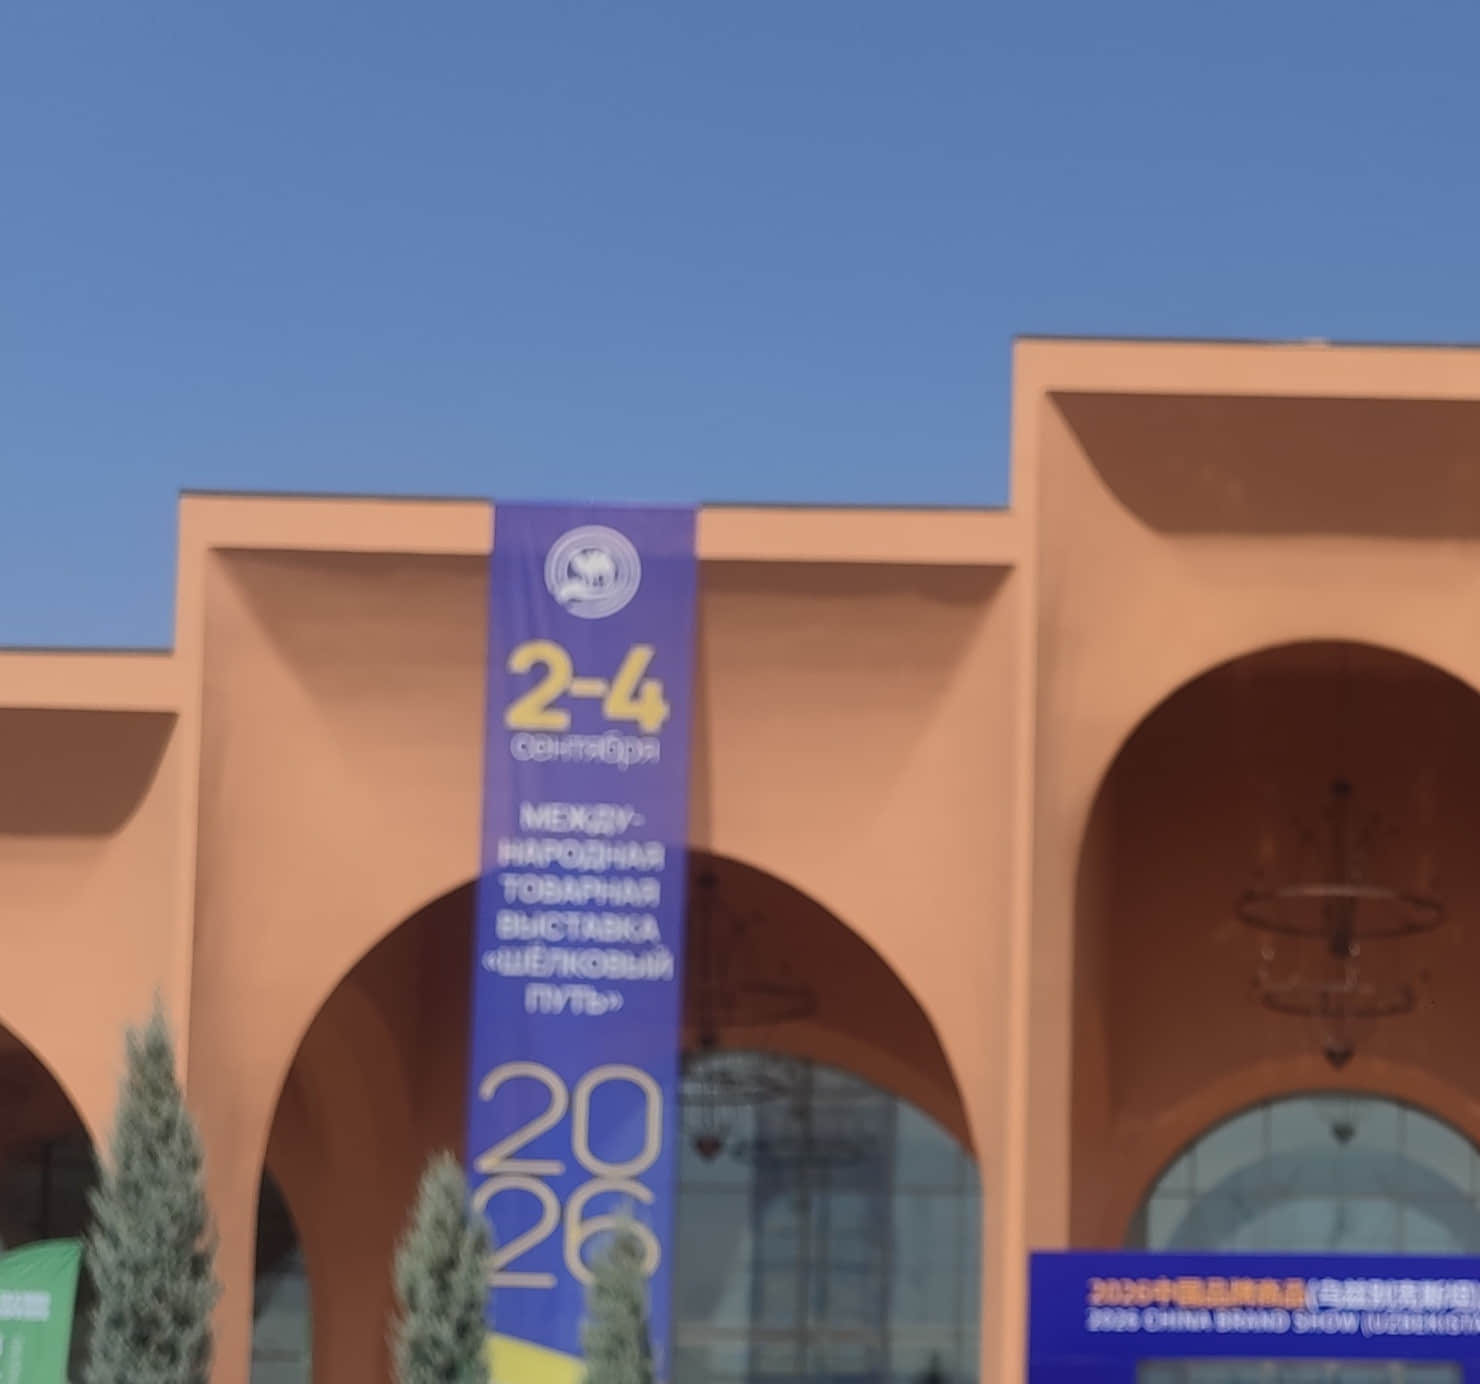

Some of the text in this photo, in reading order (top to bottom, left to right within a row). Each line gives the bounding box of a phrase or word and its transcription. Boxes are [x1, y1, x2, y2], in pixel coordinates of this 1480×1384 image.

[505, 640, 670, 733] 2-4
[511, 731, 660, 769] сентября
[499, 838, 665, 871] НАРОДНАЯ
[503, 874, 660, 907] ТОВАРНАЯ
[496, 910, 660, 942] ВЫСТАВКА
[475, 1060, 663, 1179] 20
[474, 1174, 661, 1288] 26
